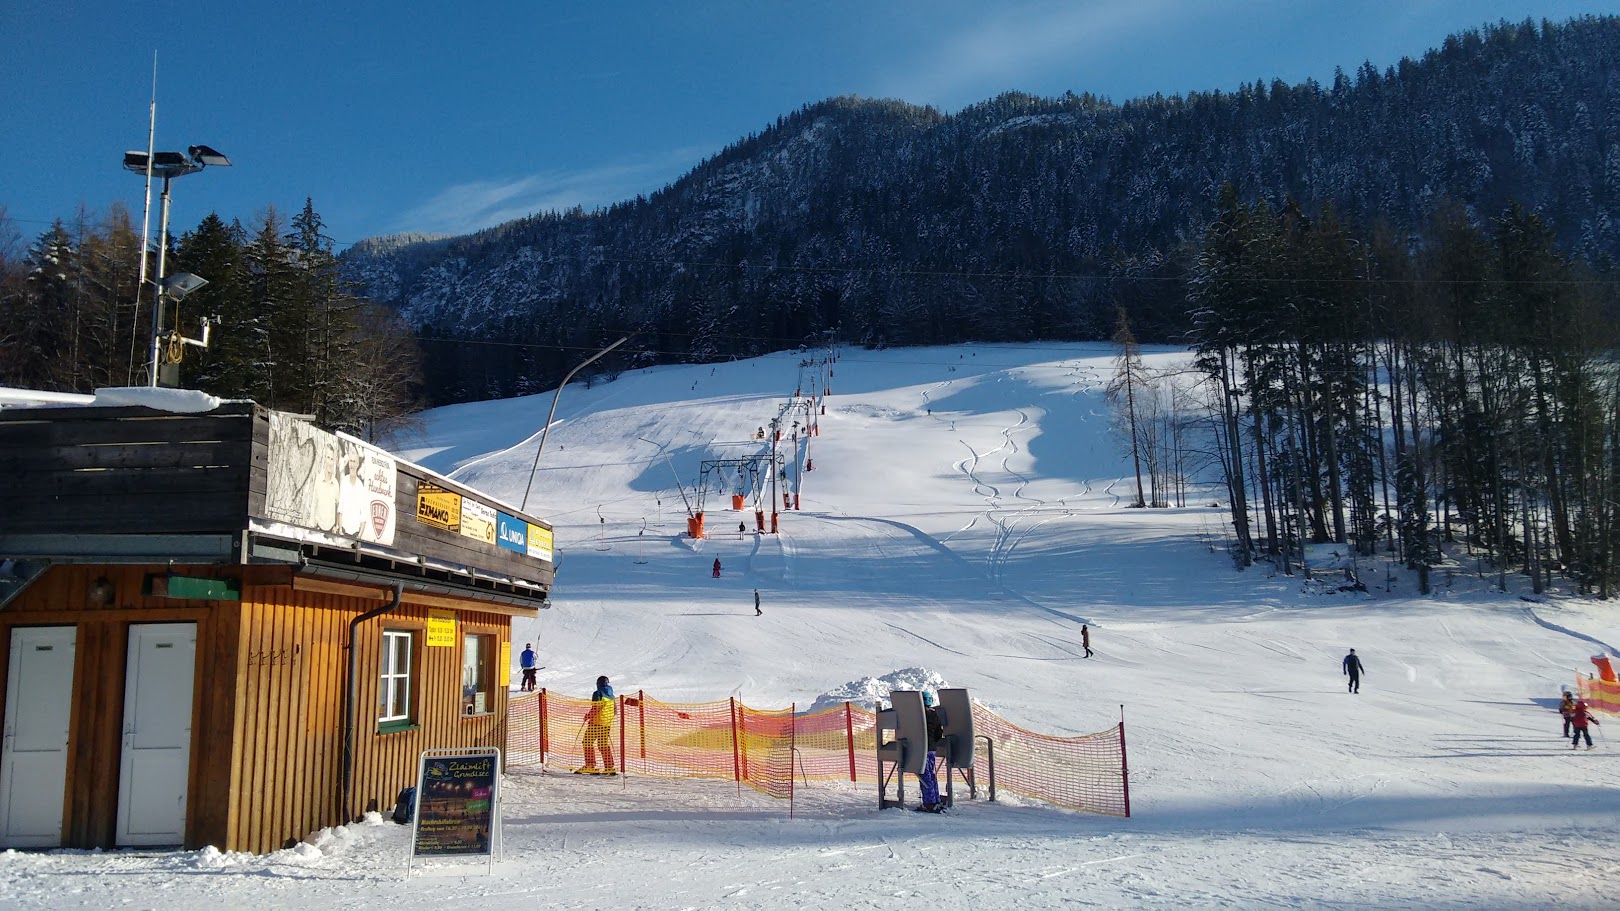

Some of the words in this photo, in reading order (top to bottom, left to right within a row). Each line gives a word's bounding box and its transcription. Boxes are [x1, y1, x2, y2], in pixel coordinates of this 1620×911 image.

[508, 530, 524, 546] UNIQA
[449, 758, 492, 771] Zlaimlift
[454, 770, 490, 778] Grundlsee
